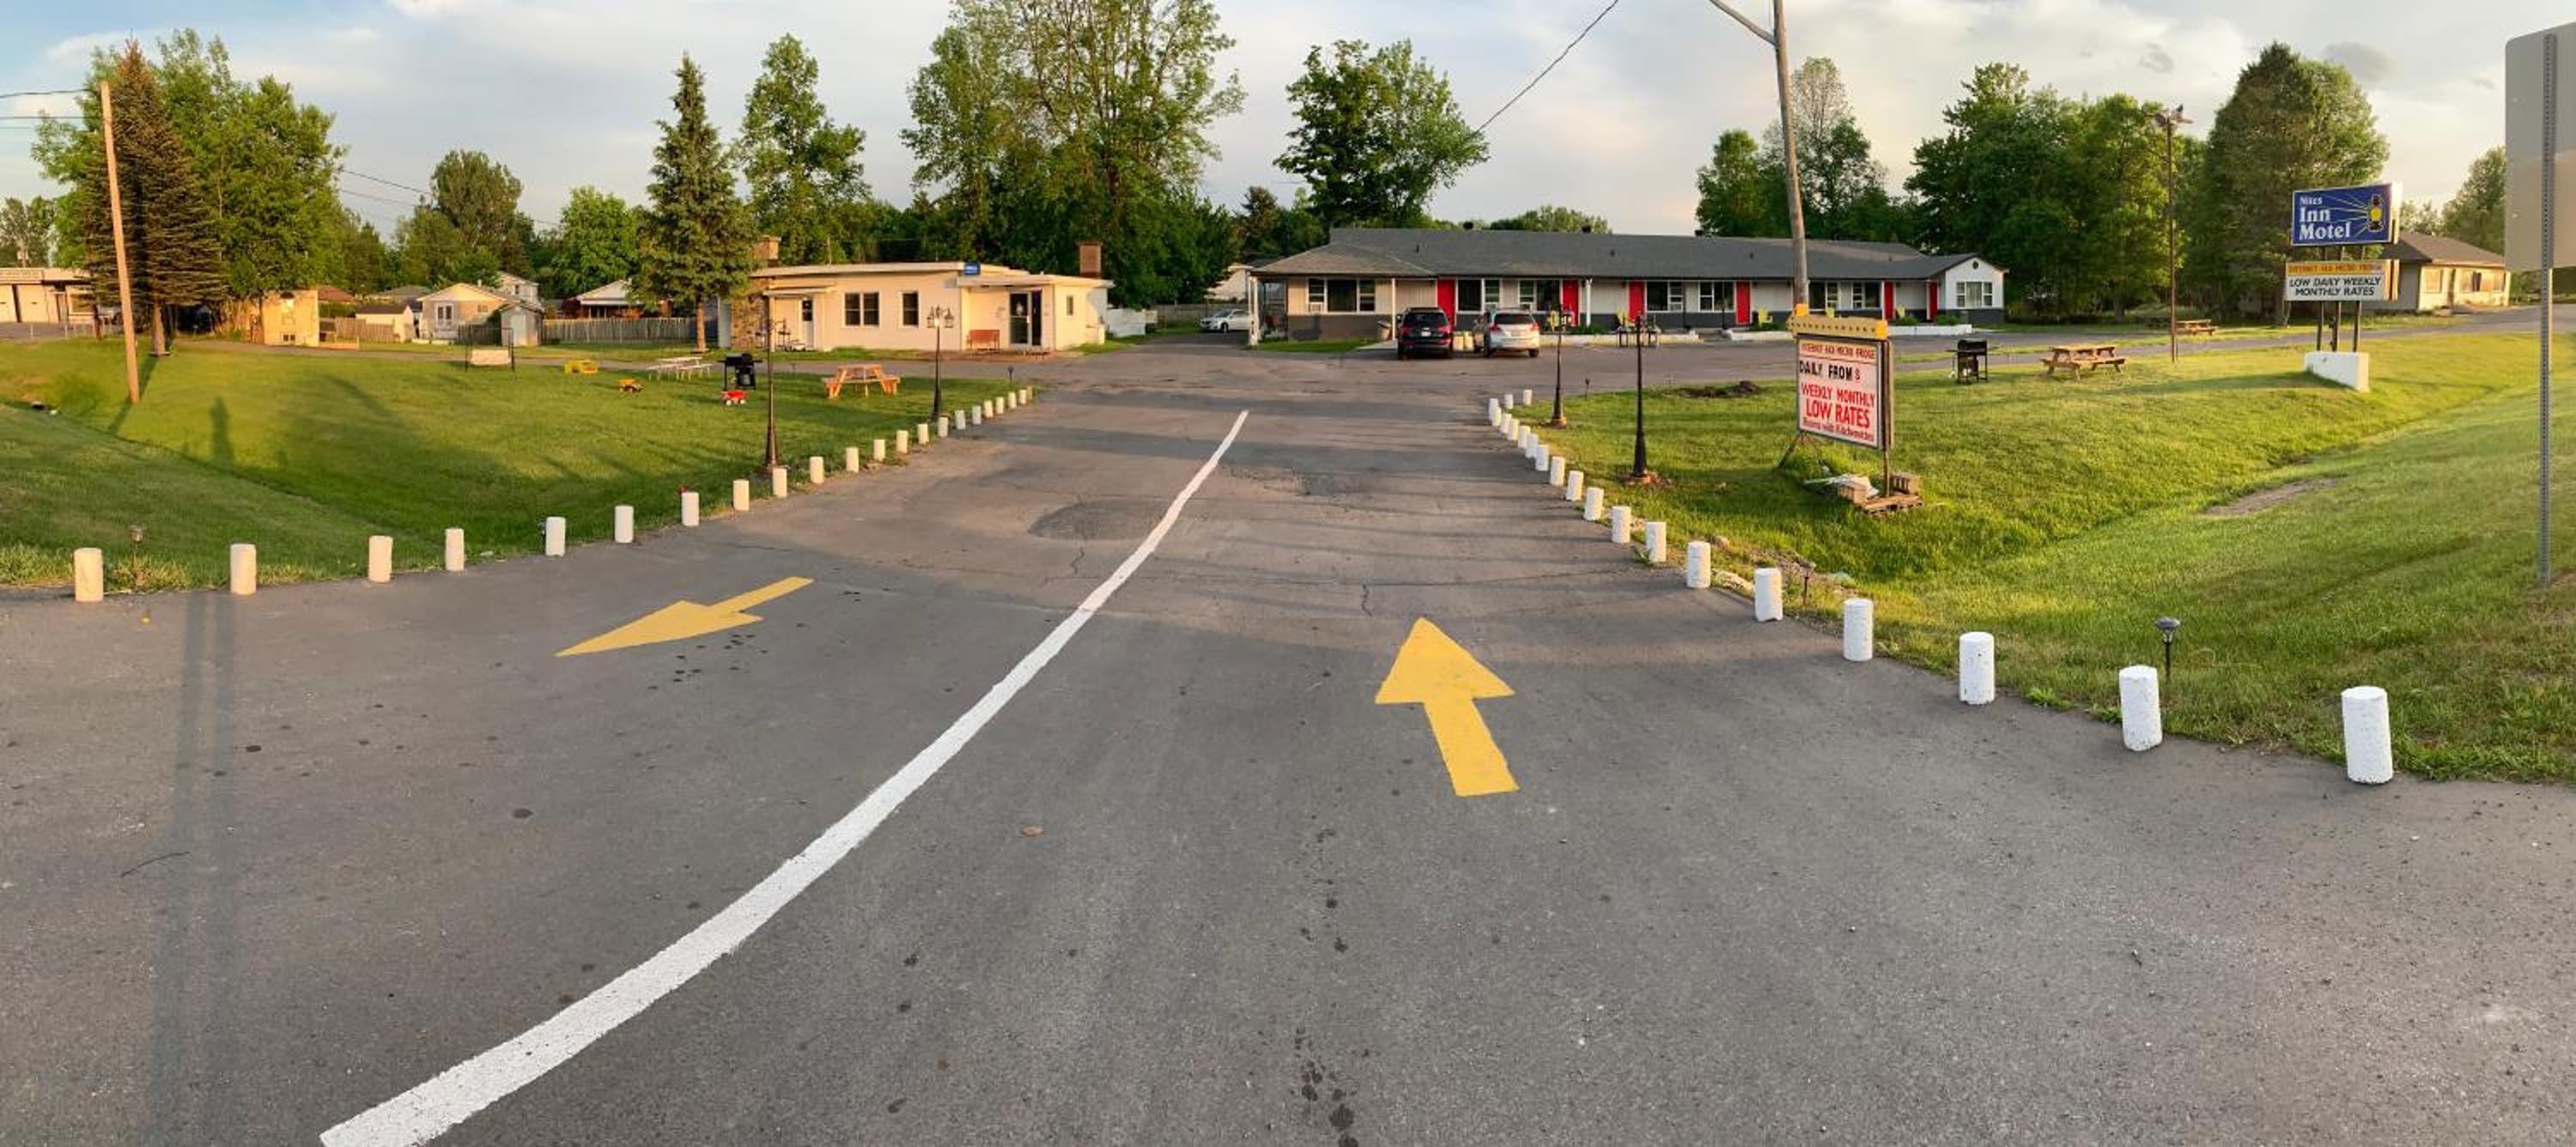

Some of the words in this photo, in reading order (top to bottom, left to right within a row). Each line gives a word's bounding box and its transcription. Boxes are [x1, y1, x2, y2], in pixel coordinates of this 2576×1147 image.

[2300, 207, 2330, 222] Inn
[2300, 222, 2351, 240] Motel
[2289, 278, 2311, 287] LOW
[2313, 277, 2340, 286] DAILY
[2342, 276, 2381, 286] WEEKLY
[2343, 287, 2375, 295] RATES
[1799, 361, 1823, 375] DAILY
[1828, 364, 1853, 380] FROM
[1801, 383, 1832, 400] WEEKLY
[1837, 389, 1875, 408] MONTHLY
[1807, 398, 1832, 419] LOW
[1836, 404, 1870, 428] RATES
